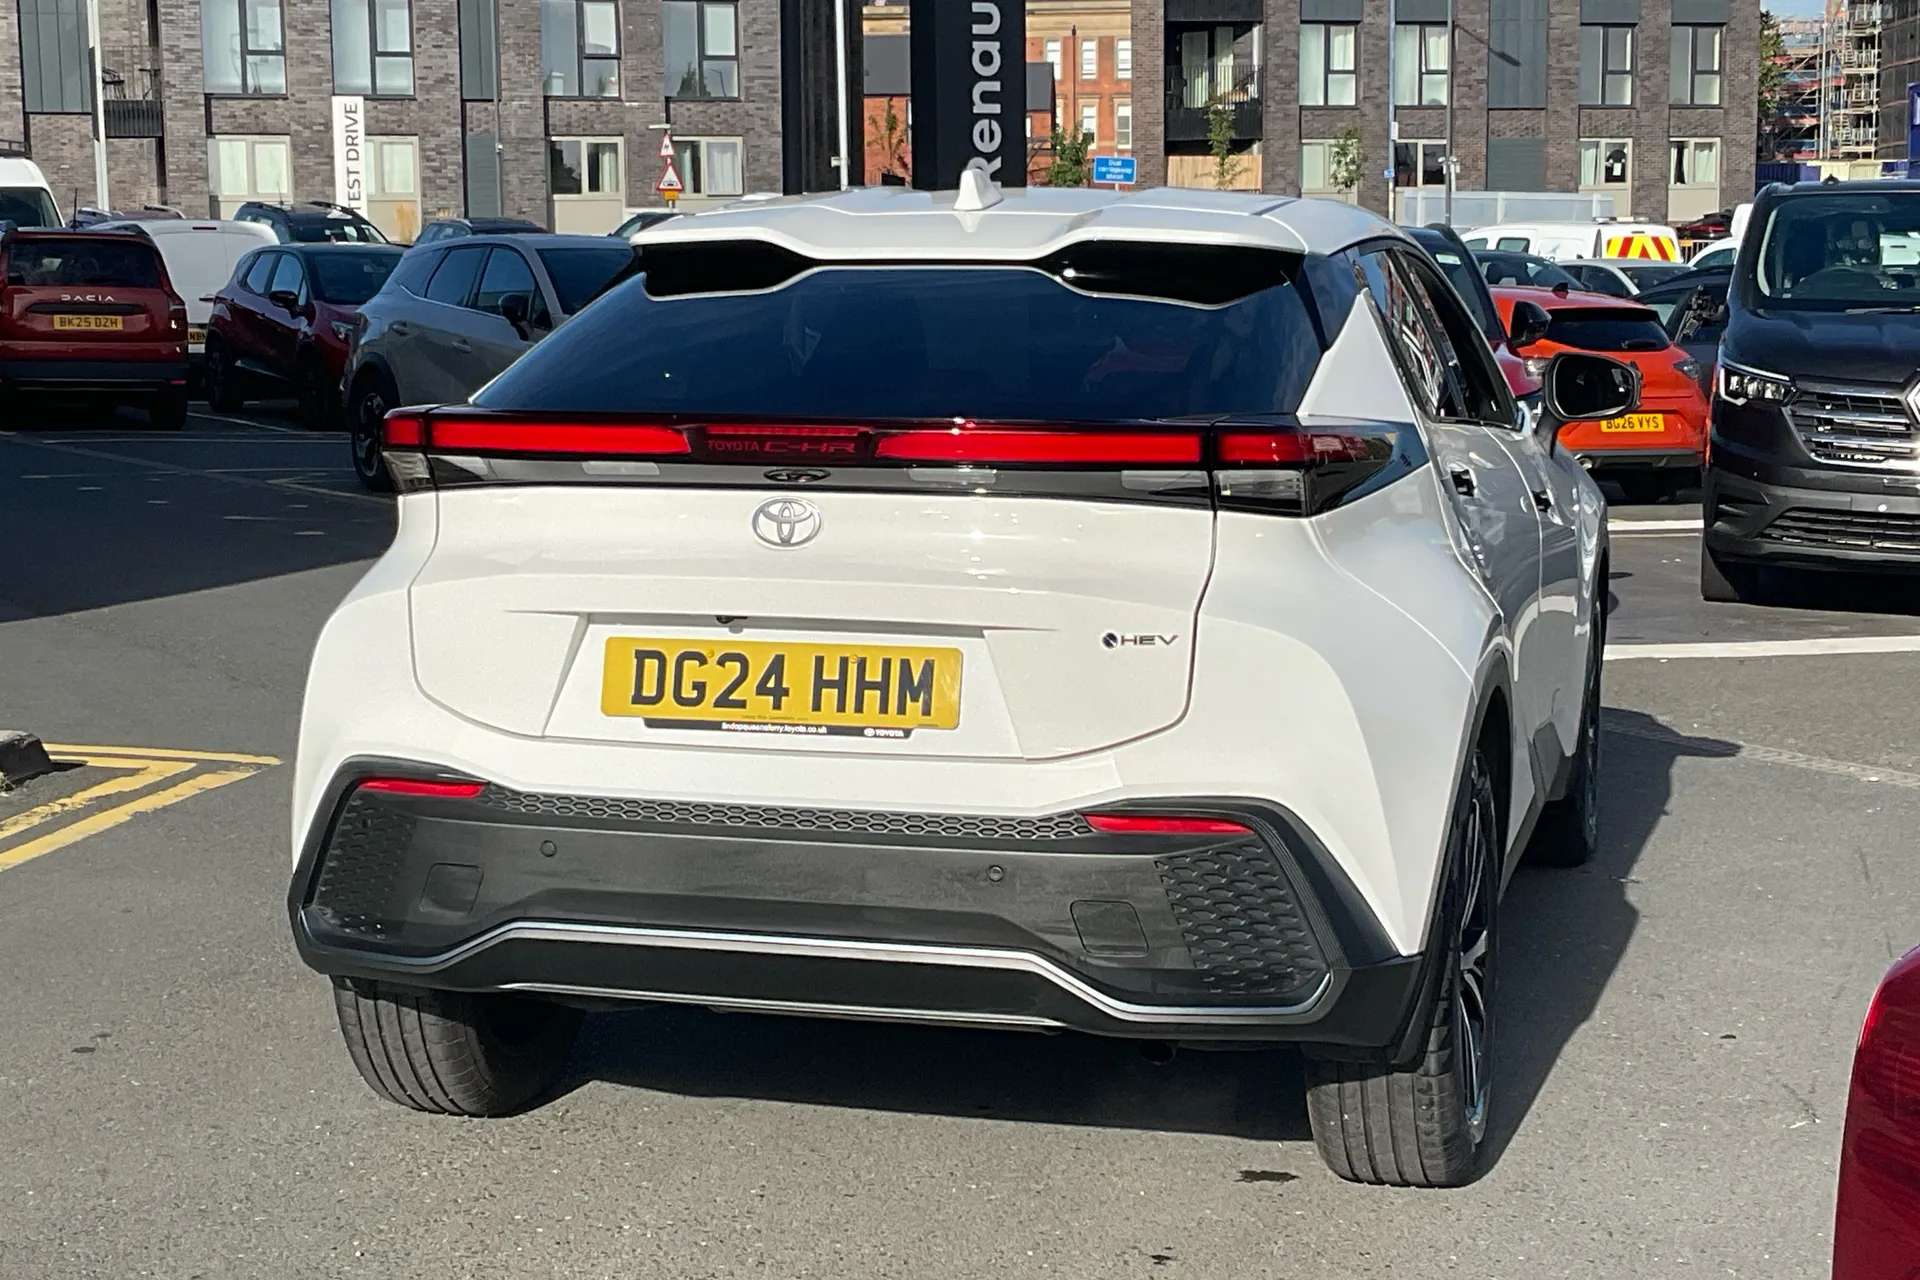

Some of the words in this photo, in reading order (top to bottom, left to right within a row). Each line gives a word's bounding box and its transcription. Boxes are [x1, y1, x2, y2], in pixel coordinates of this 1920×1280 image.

[344, 103, 360, 161] DRIVE
[347, 167, 362, 210] TEST
[60, 294, 114, 302] DACIA
[1637, 416, 1659, 428] VYS
[707, 439, 760, 452] TOYOTA
[763, 441, 856, 453] C-HR
[1121, 634, 1178, 646] HEV
[630, 648, 790, 711] DG24
[811, 655, 936, 717] HHM
[875, 729, 905, 738] TOYOTA
